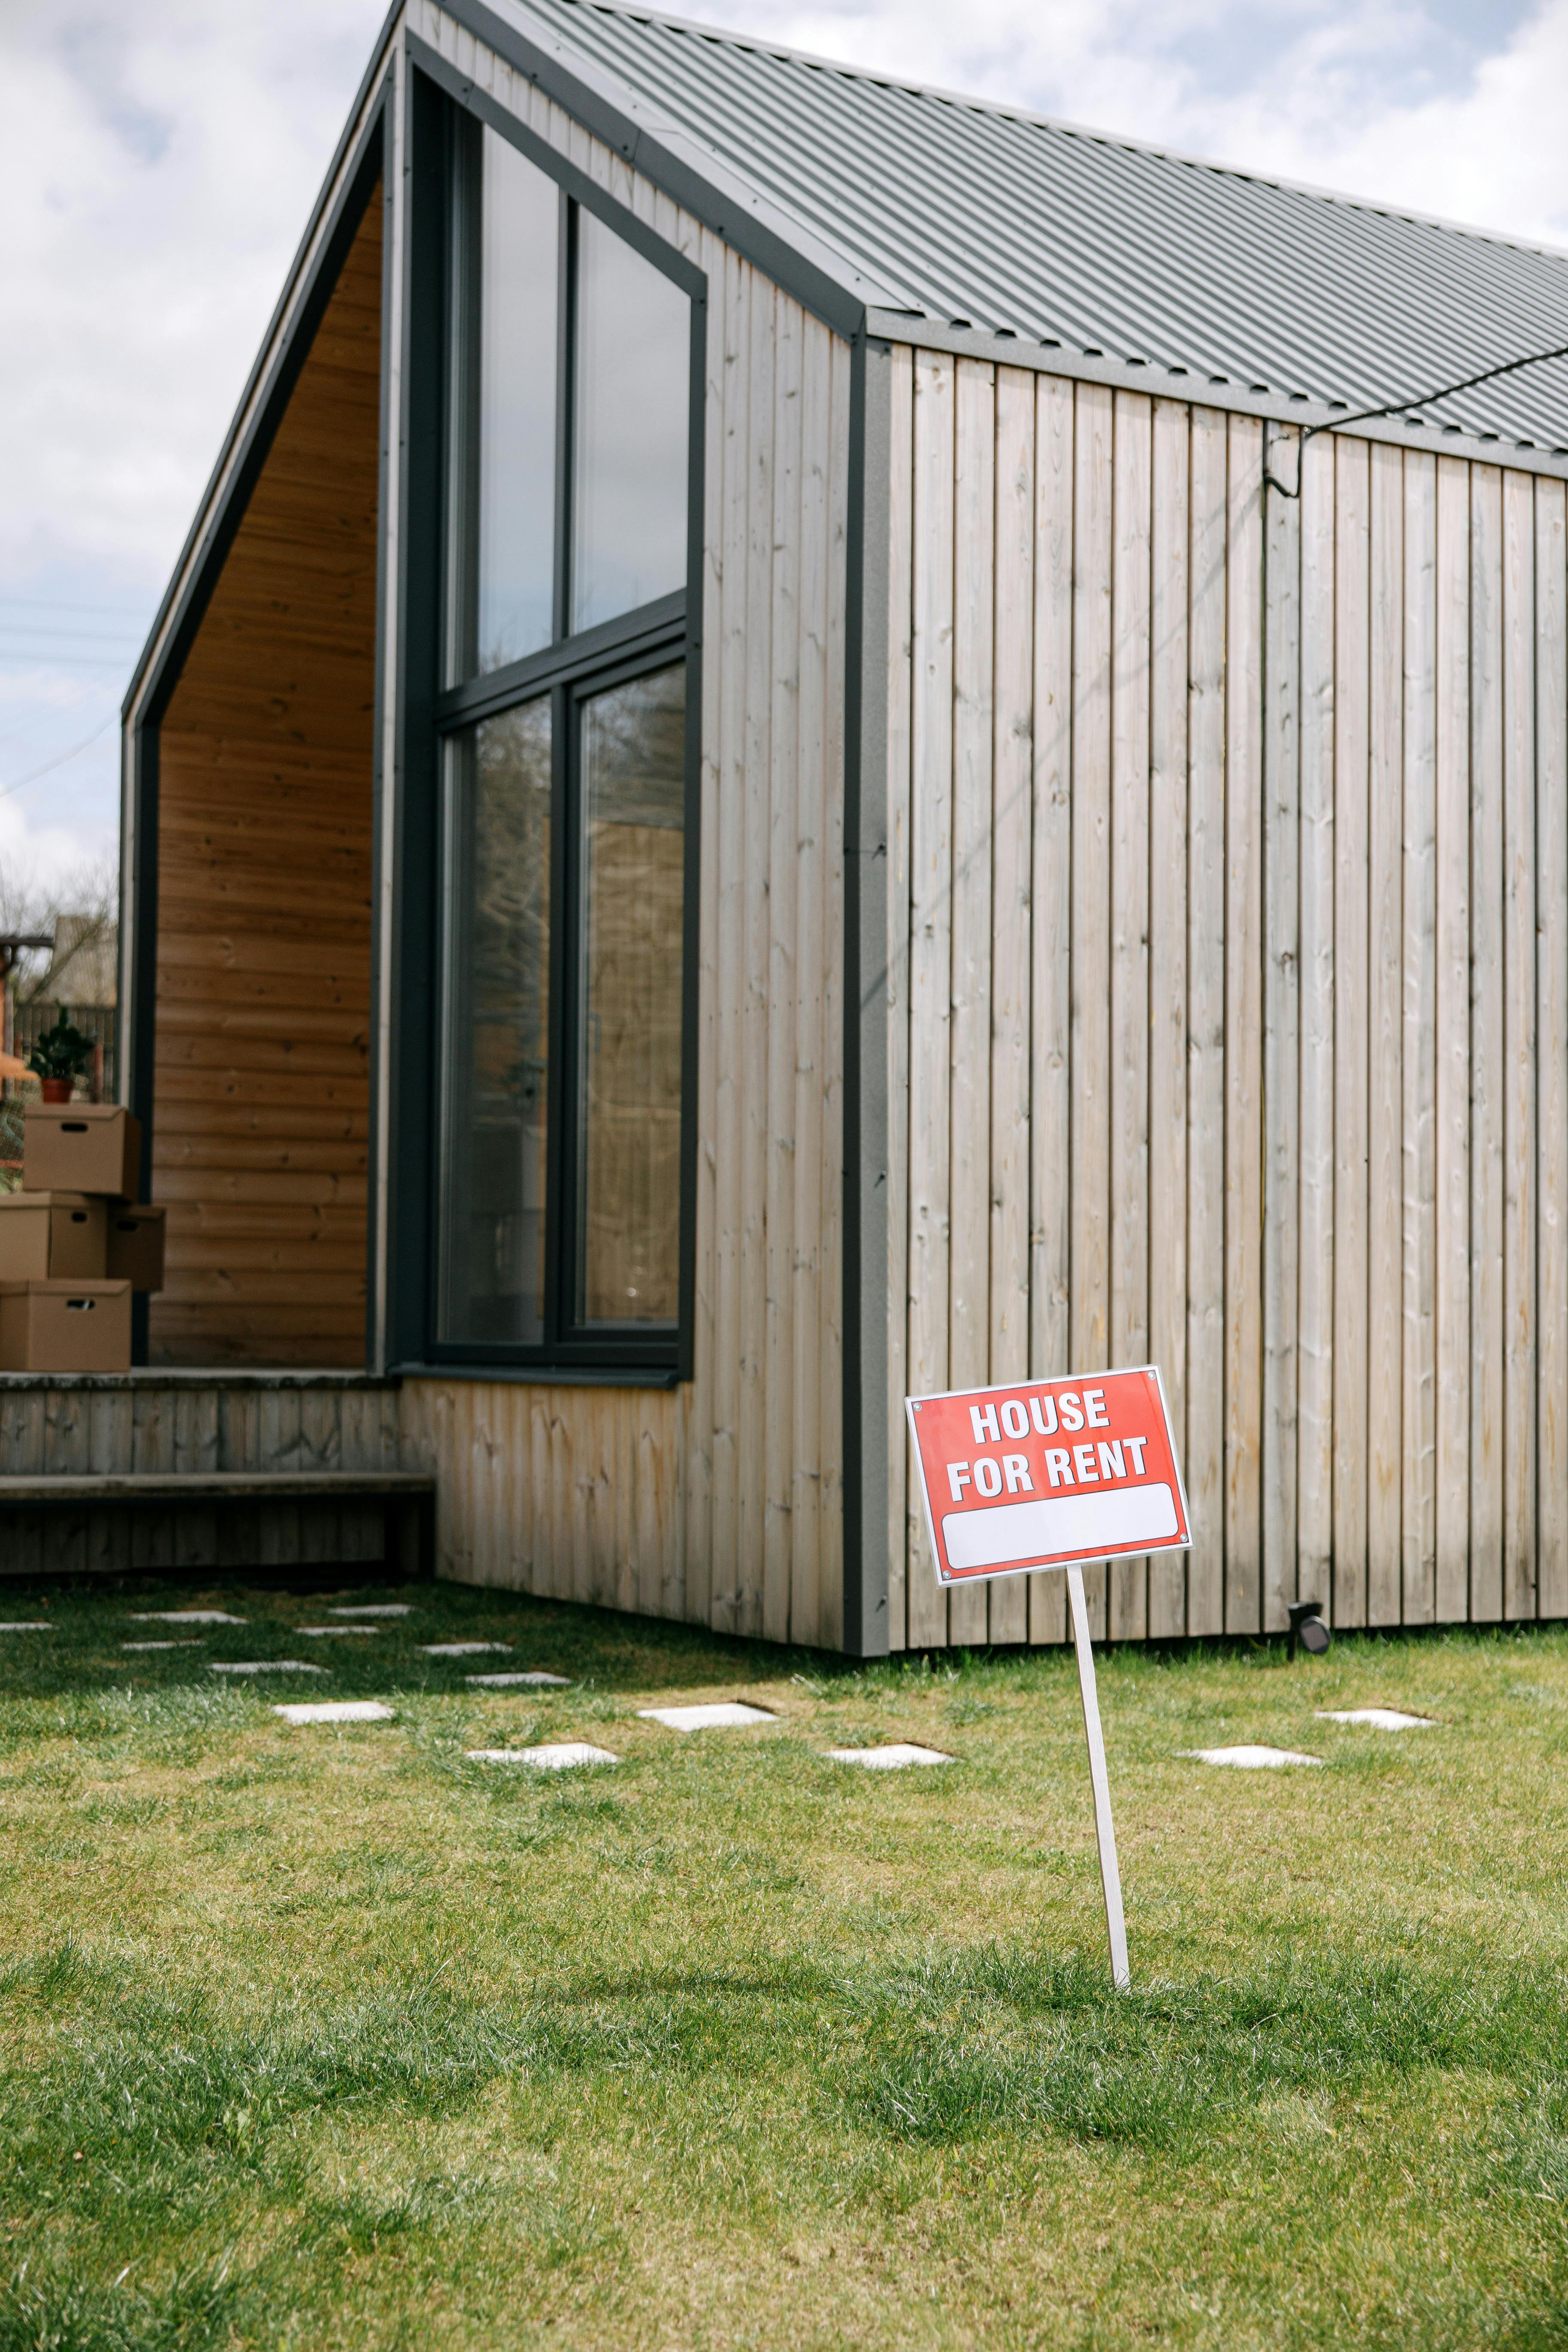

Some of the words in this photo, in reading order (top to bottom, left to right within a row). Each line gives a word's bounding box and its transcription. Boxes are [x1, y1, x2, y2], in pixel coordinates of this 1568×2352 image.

[969, 1389, 1110, 1445] HOUSE
[946, 1454, 1035, 1502] FOR
[1044, 1436, 1147, 1488] RENT
